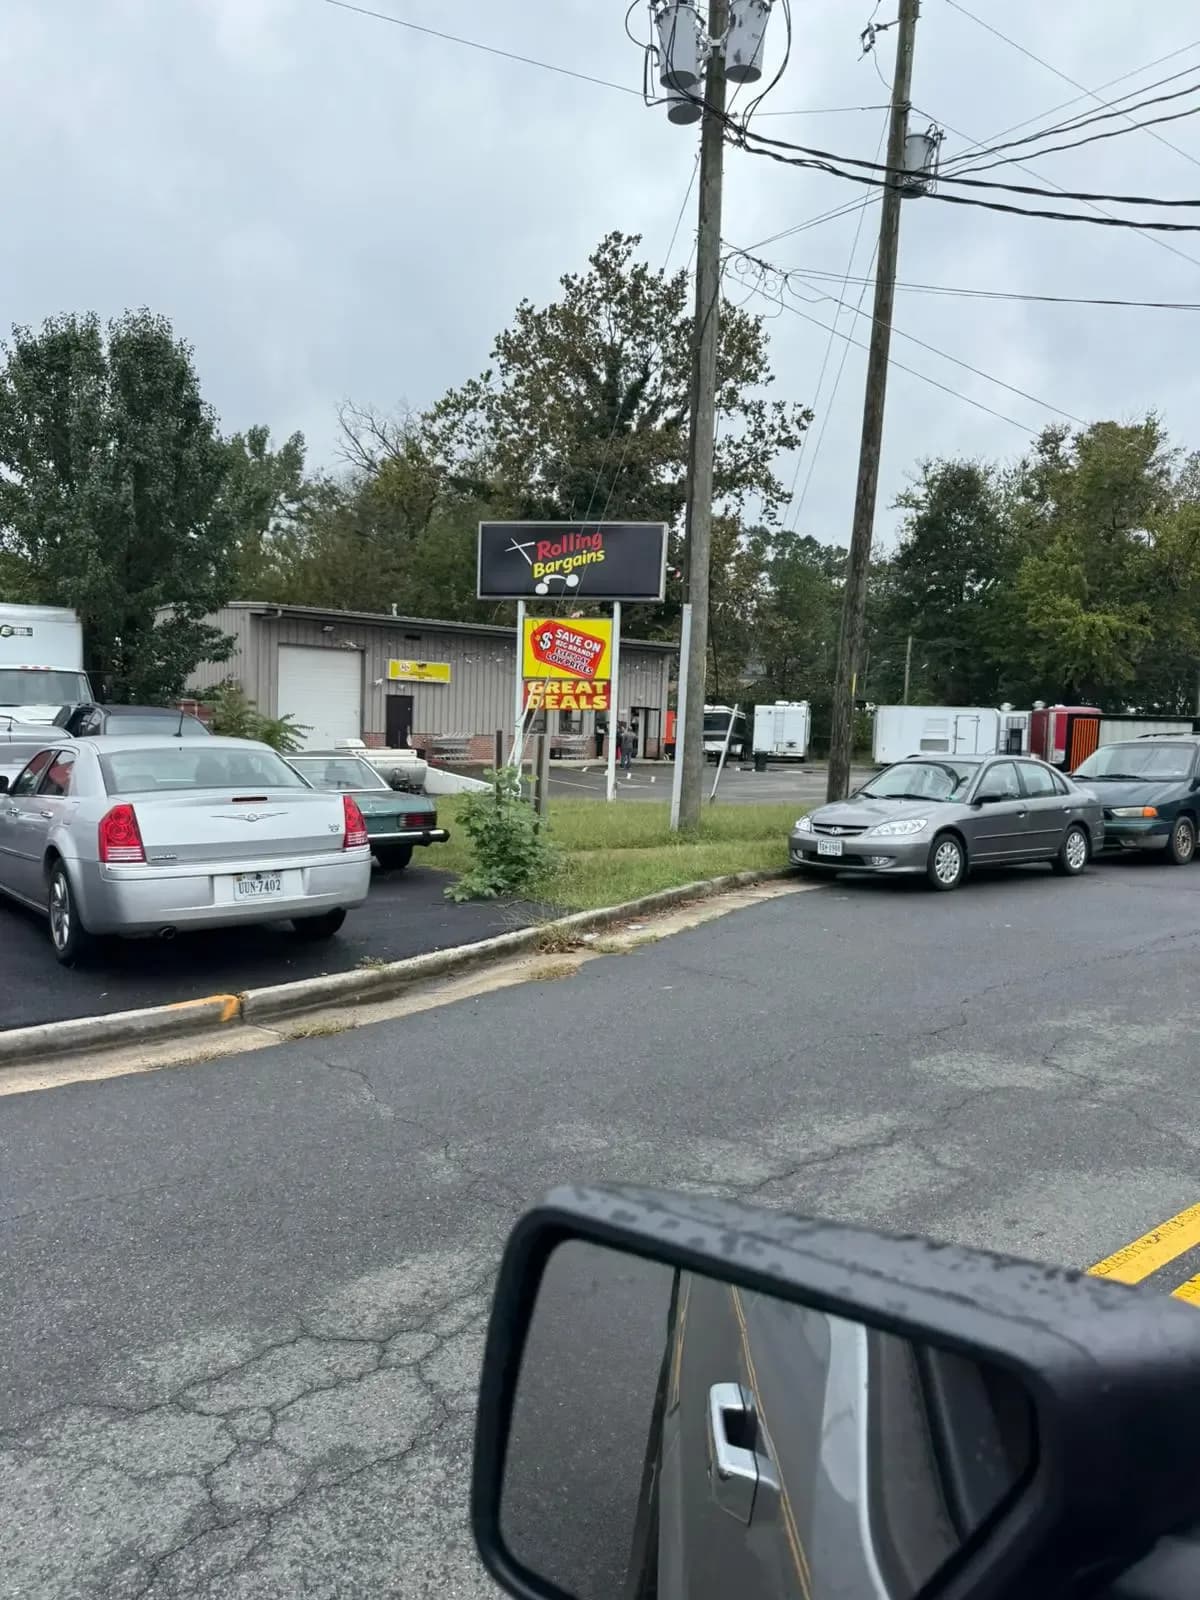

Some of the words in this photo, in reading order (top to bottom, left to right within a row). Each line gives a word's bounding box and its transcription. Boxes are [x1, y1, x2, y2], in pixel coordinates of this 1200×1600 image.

[537, 533, 602, 560] Rolling
[533, 550, 605, 578] Bargains
[555, 629, 584, 646] SAVE
[584, 640, 601, 653] ON
[567, 645, 594, 658] BRANDS
[546, 652, 564, 664] LOW
[565, 658, 594, 674] PRICES
[527, 681, 607, 694] GREAT
[528, 695, 607, 709] DEALS
